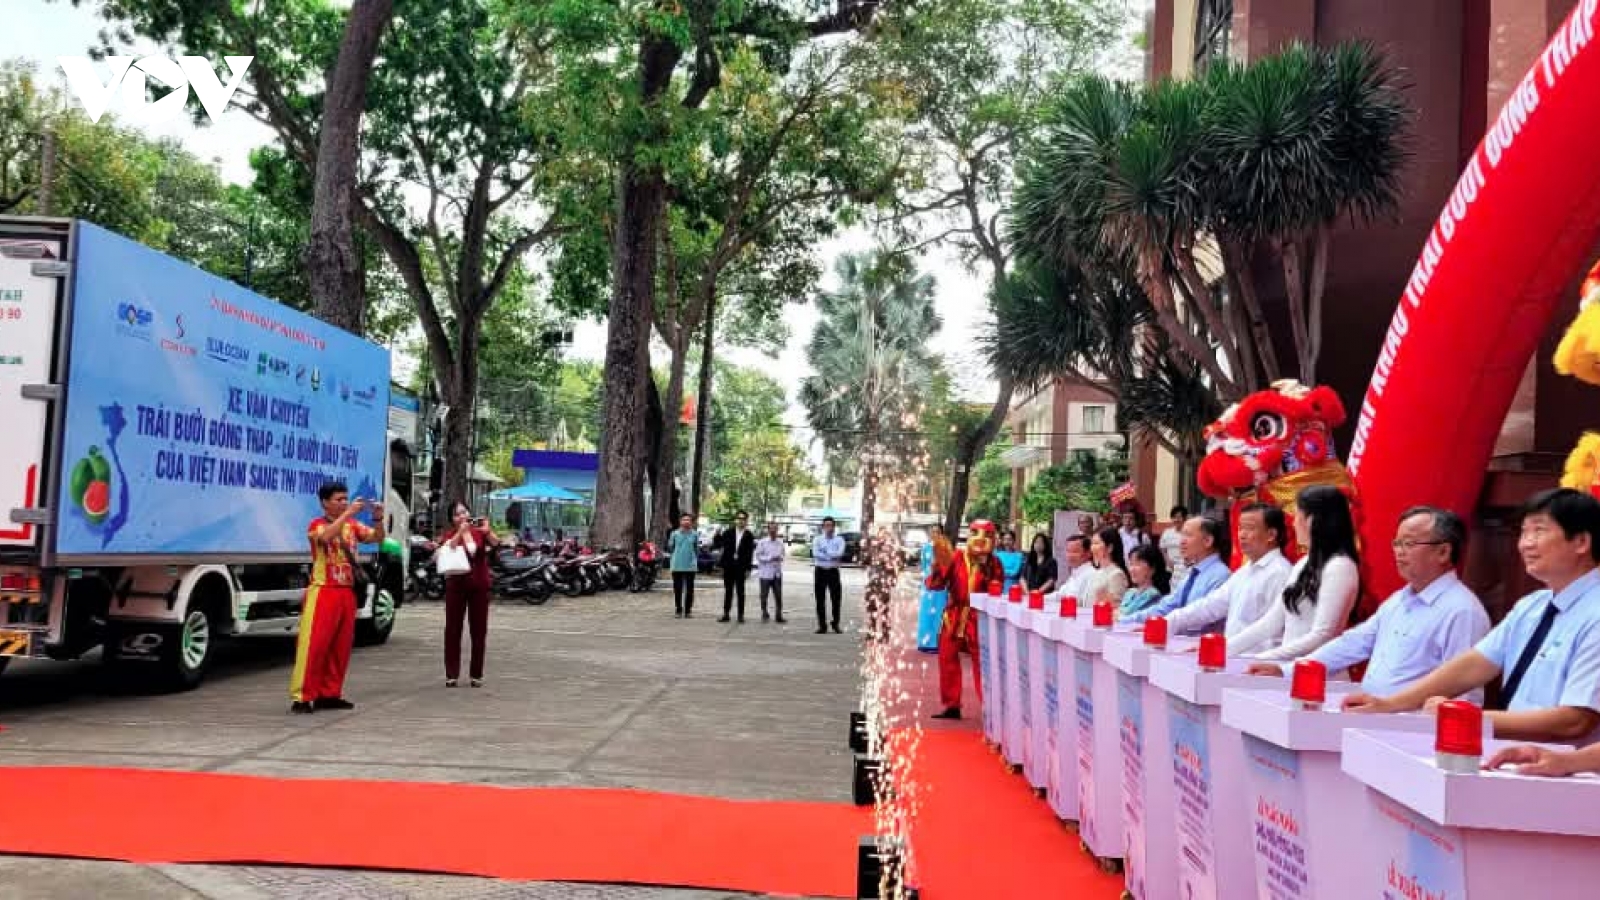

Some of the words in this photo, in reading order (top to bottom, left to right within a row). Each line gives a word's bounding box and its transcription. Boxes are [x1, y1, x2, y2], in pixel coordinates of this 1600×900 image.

[227, 387, 243, 414] XE
[218, 458, 247, 486] NAM
[250, 464, 278, 490] SANG
